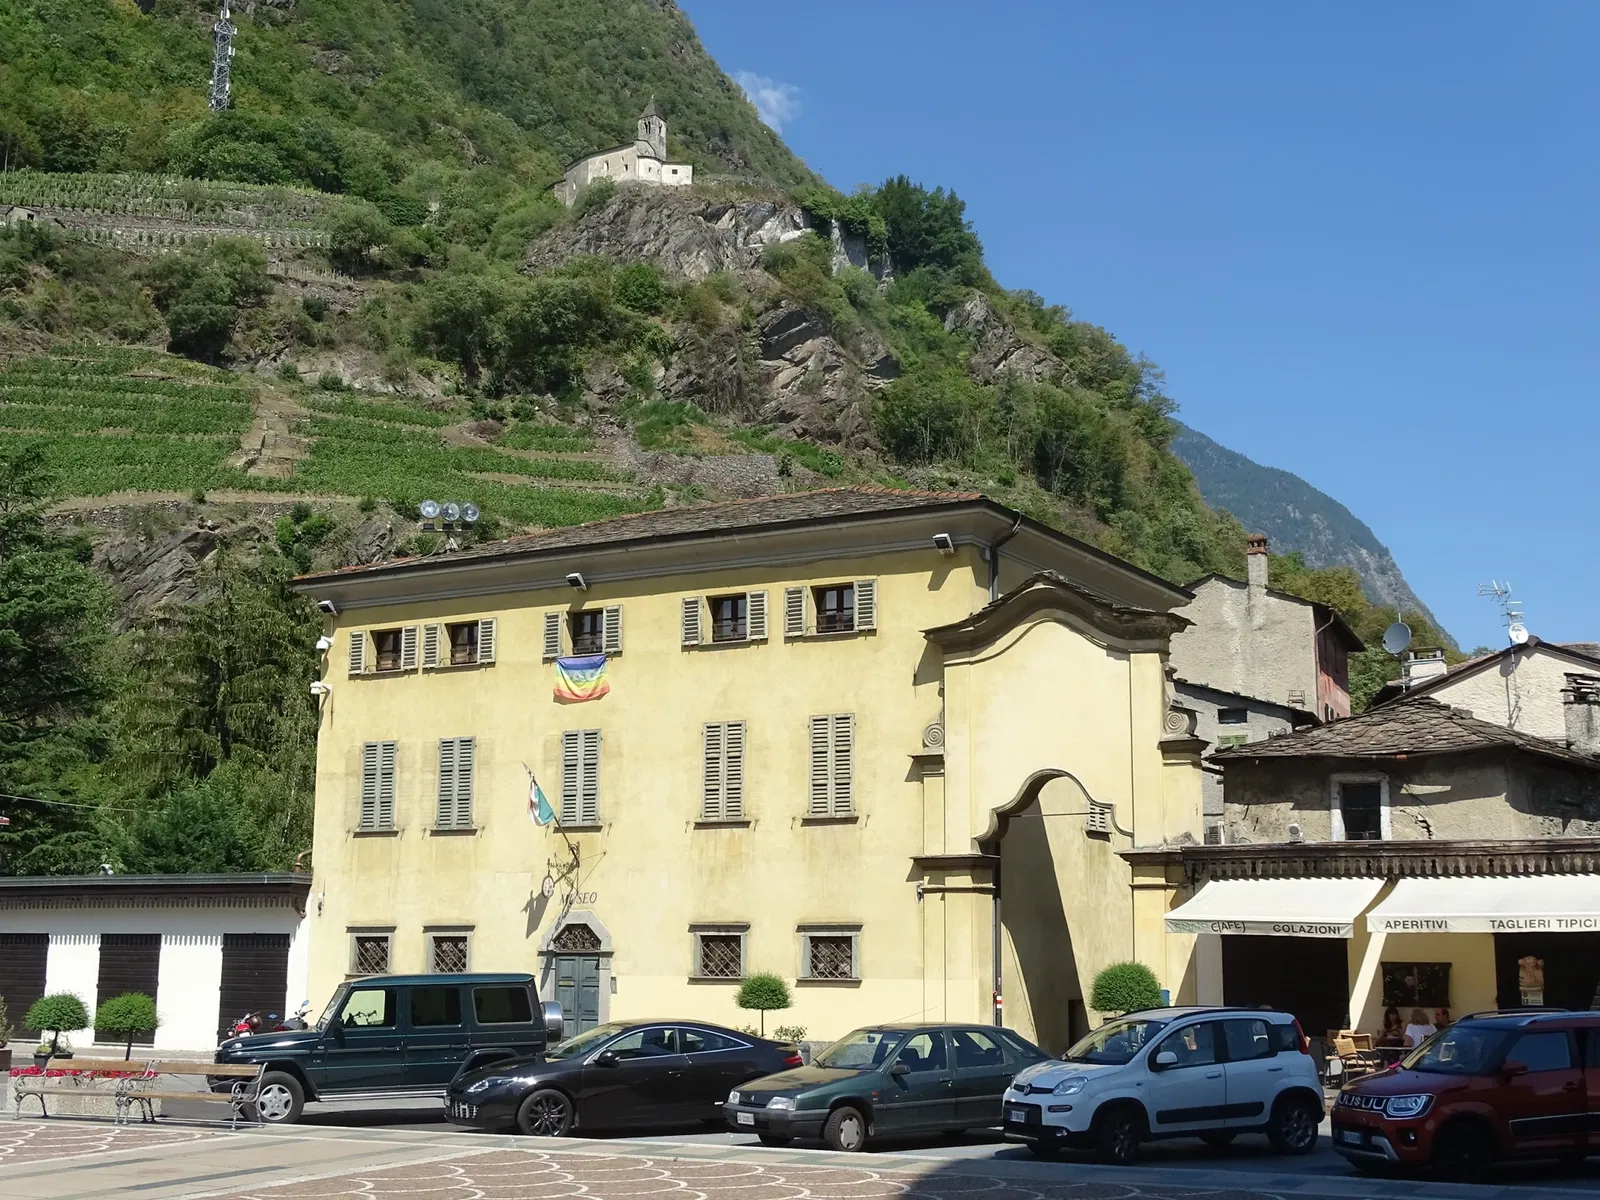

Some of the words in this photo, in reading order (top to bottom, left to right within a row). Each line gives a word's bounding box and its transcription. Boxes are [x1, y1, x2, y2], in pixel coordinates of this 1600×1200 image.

[1384, 919, 1448, 929] APERITIVI
[1489, 919, 1551, 929] TAGLIERI
[1556, 918, 1597, 928] TIPICI
[1272, 924, 1341, 934] COLAZIONI
